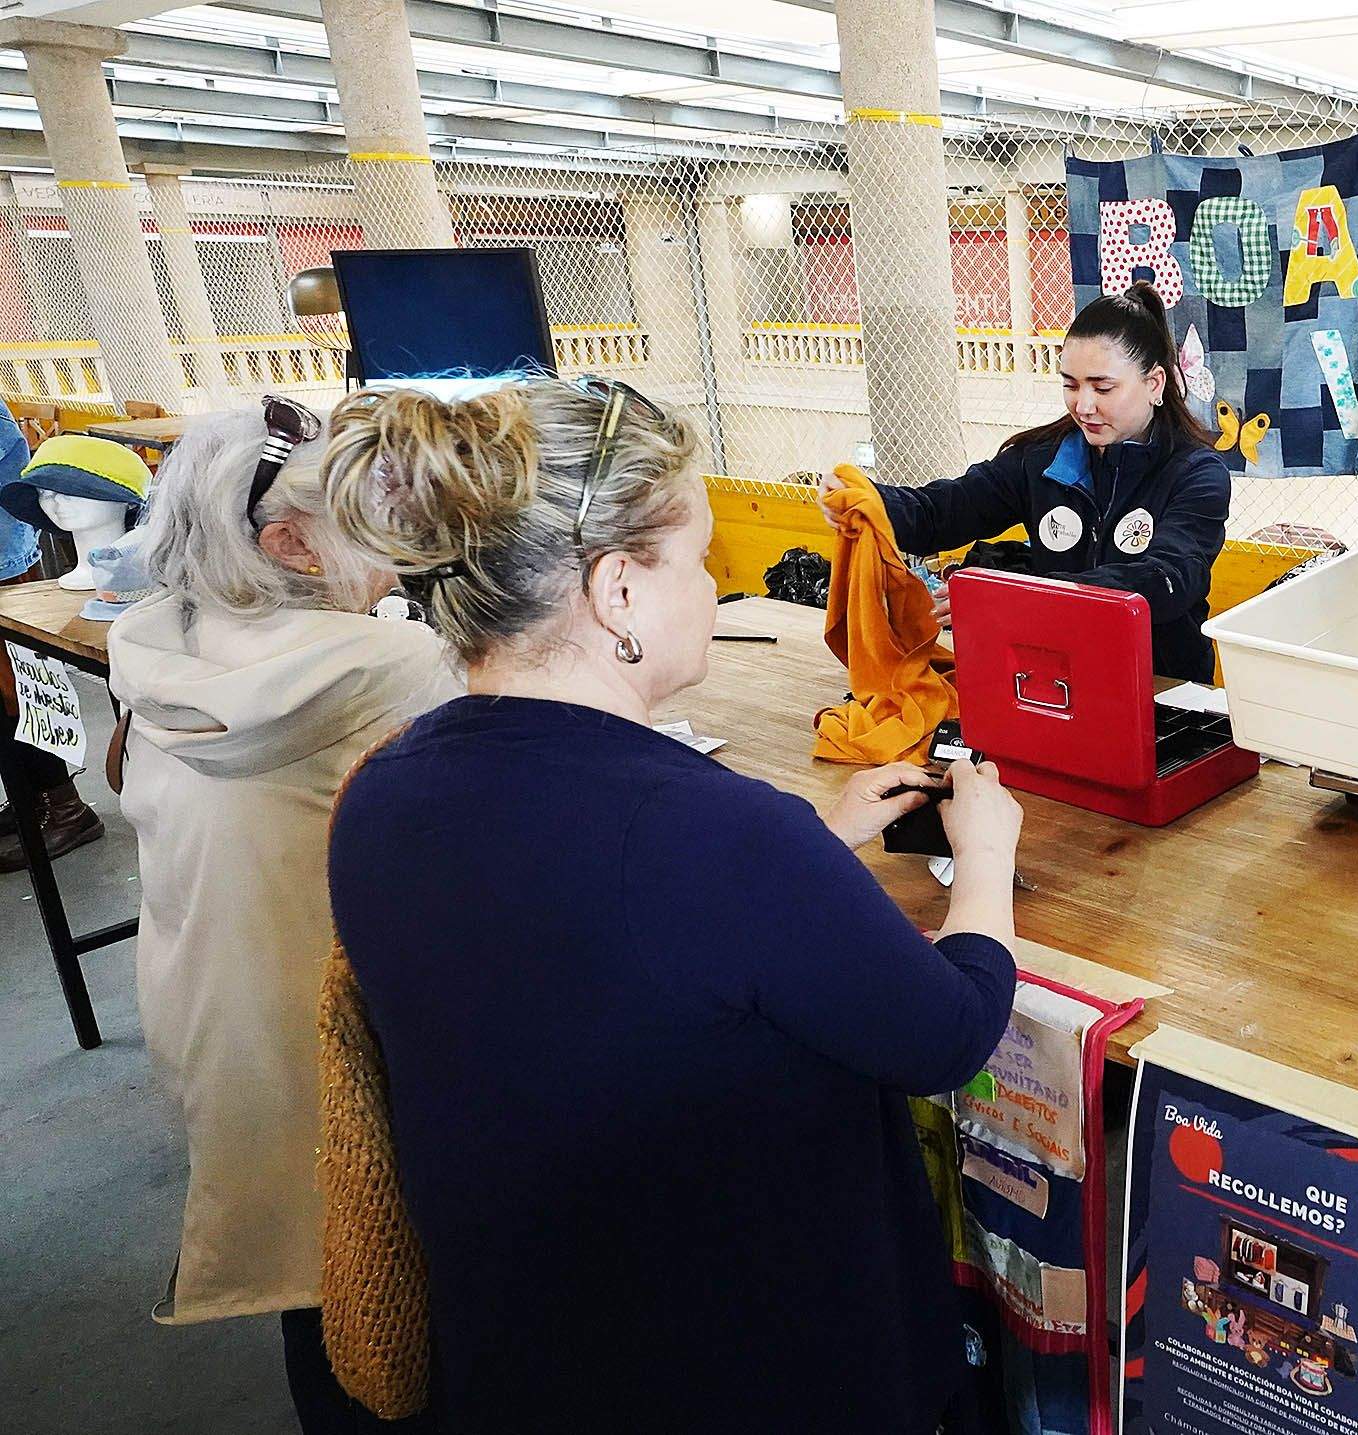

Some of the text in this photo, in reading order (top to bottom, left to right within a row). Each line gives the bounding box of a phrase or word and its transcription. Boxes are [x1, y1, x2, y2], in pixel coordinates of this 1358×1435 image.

[1164, 1104, 1224, 1140] Boa Vida
[1208, 1168, 1346, 1234] RECOLLEMOS?
[1305, 1185, 1348, 1214] QUE
[1154, 1340, 1166, 1350] CO
[1166, 1346, 1190, 1360] MEDIO
[1189, 1357, 1227, 1378] AMBIENTE
[1233, 1376, 1254, 1392] COAS
[1254, 1386, 1290, 1407] PERSOAS
[1290, 1402, 1302, 1413] EN
[1302, 1407, 1327, 1424] RISCO
[1327, 1419, 1339, 1431] DE
[1167, 1336, 1212, 1362] COLABORAR
[1230, 1364, 1276, 1390] ASOCIACIÓN
[1276, 1384, 1293, 1398] BOA
[1294, 1392, 1313, 1408] VIDA
